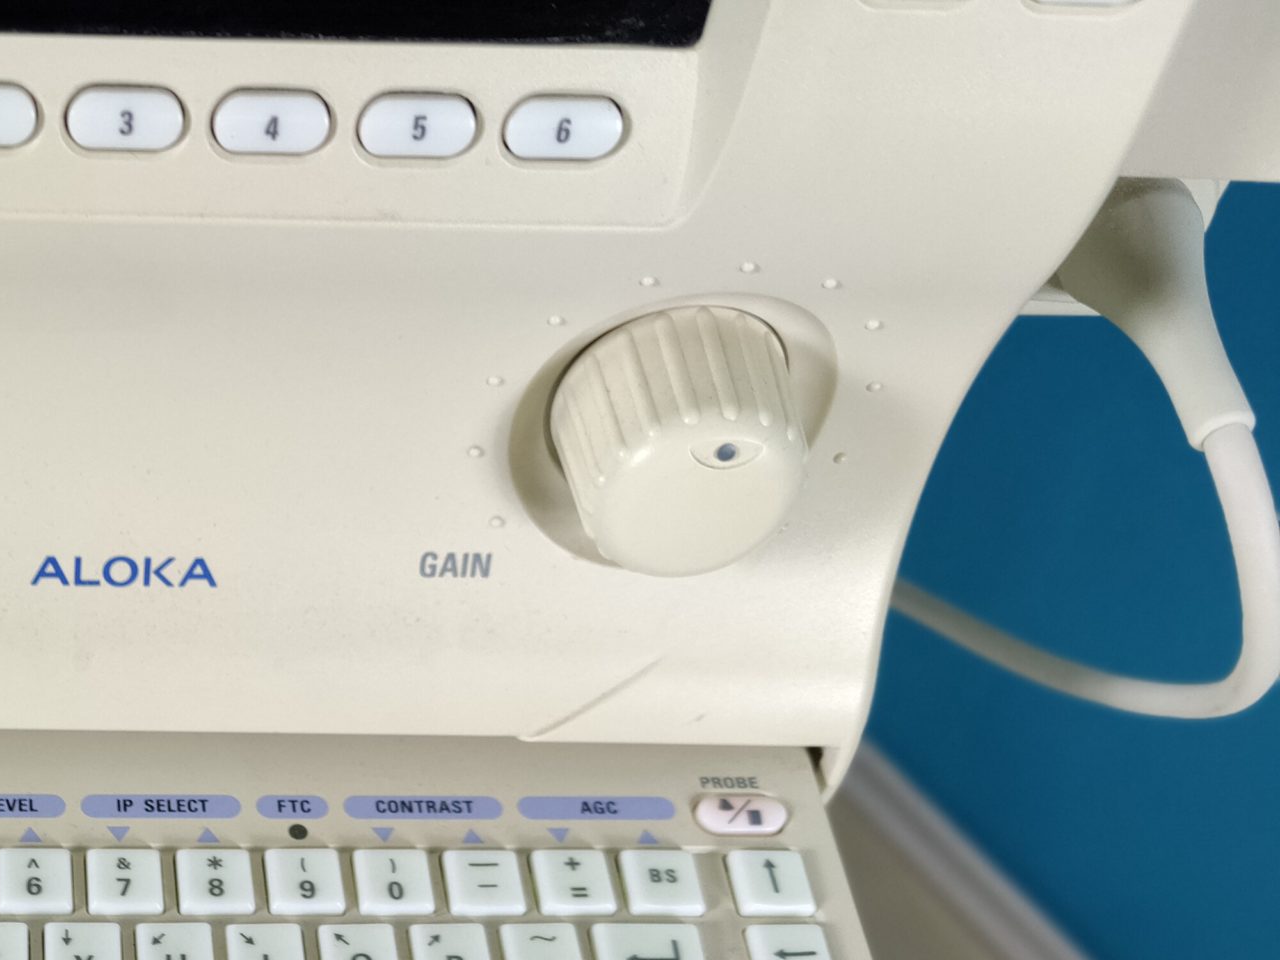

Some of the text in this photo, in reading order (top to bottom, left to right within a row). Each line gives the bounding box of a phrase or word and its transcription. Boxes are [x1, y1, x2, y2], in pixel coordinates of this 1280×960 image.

[118, 110, 134, 136] 3
[264, 115, 279, 141] 4
[411, 115, 428, 142] 5
[555, 117, 572, 144] 6
[30, 555, 217, 588] ALOKA
[419, 551, 493, 579] GAIN
[699, 776, 759, 789] PROBE
[116, 798, 209, 813] IP SELECT
[276, 799, 312, 814] FTC
[375, 799, 473, 814] CONTRAST
[580, 800, 618, 815] AGC
[25, 876, 43, 896] 6
[648, 868, 678, 884] BS
[115, 877, 132, 897] 7
[207, 877, 225, 897] 8
[298, 879, 317, 900] 9
[387, 880, 405, 901] 0
